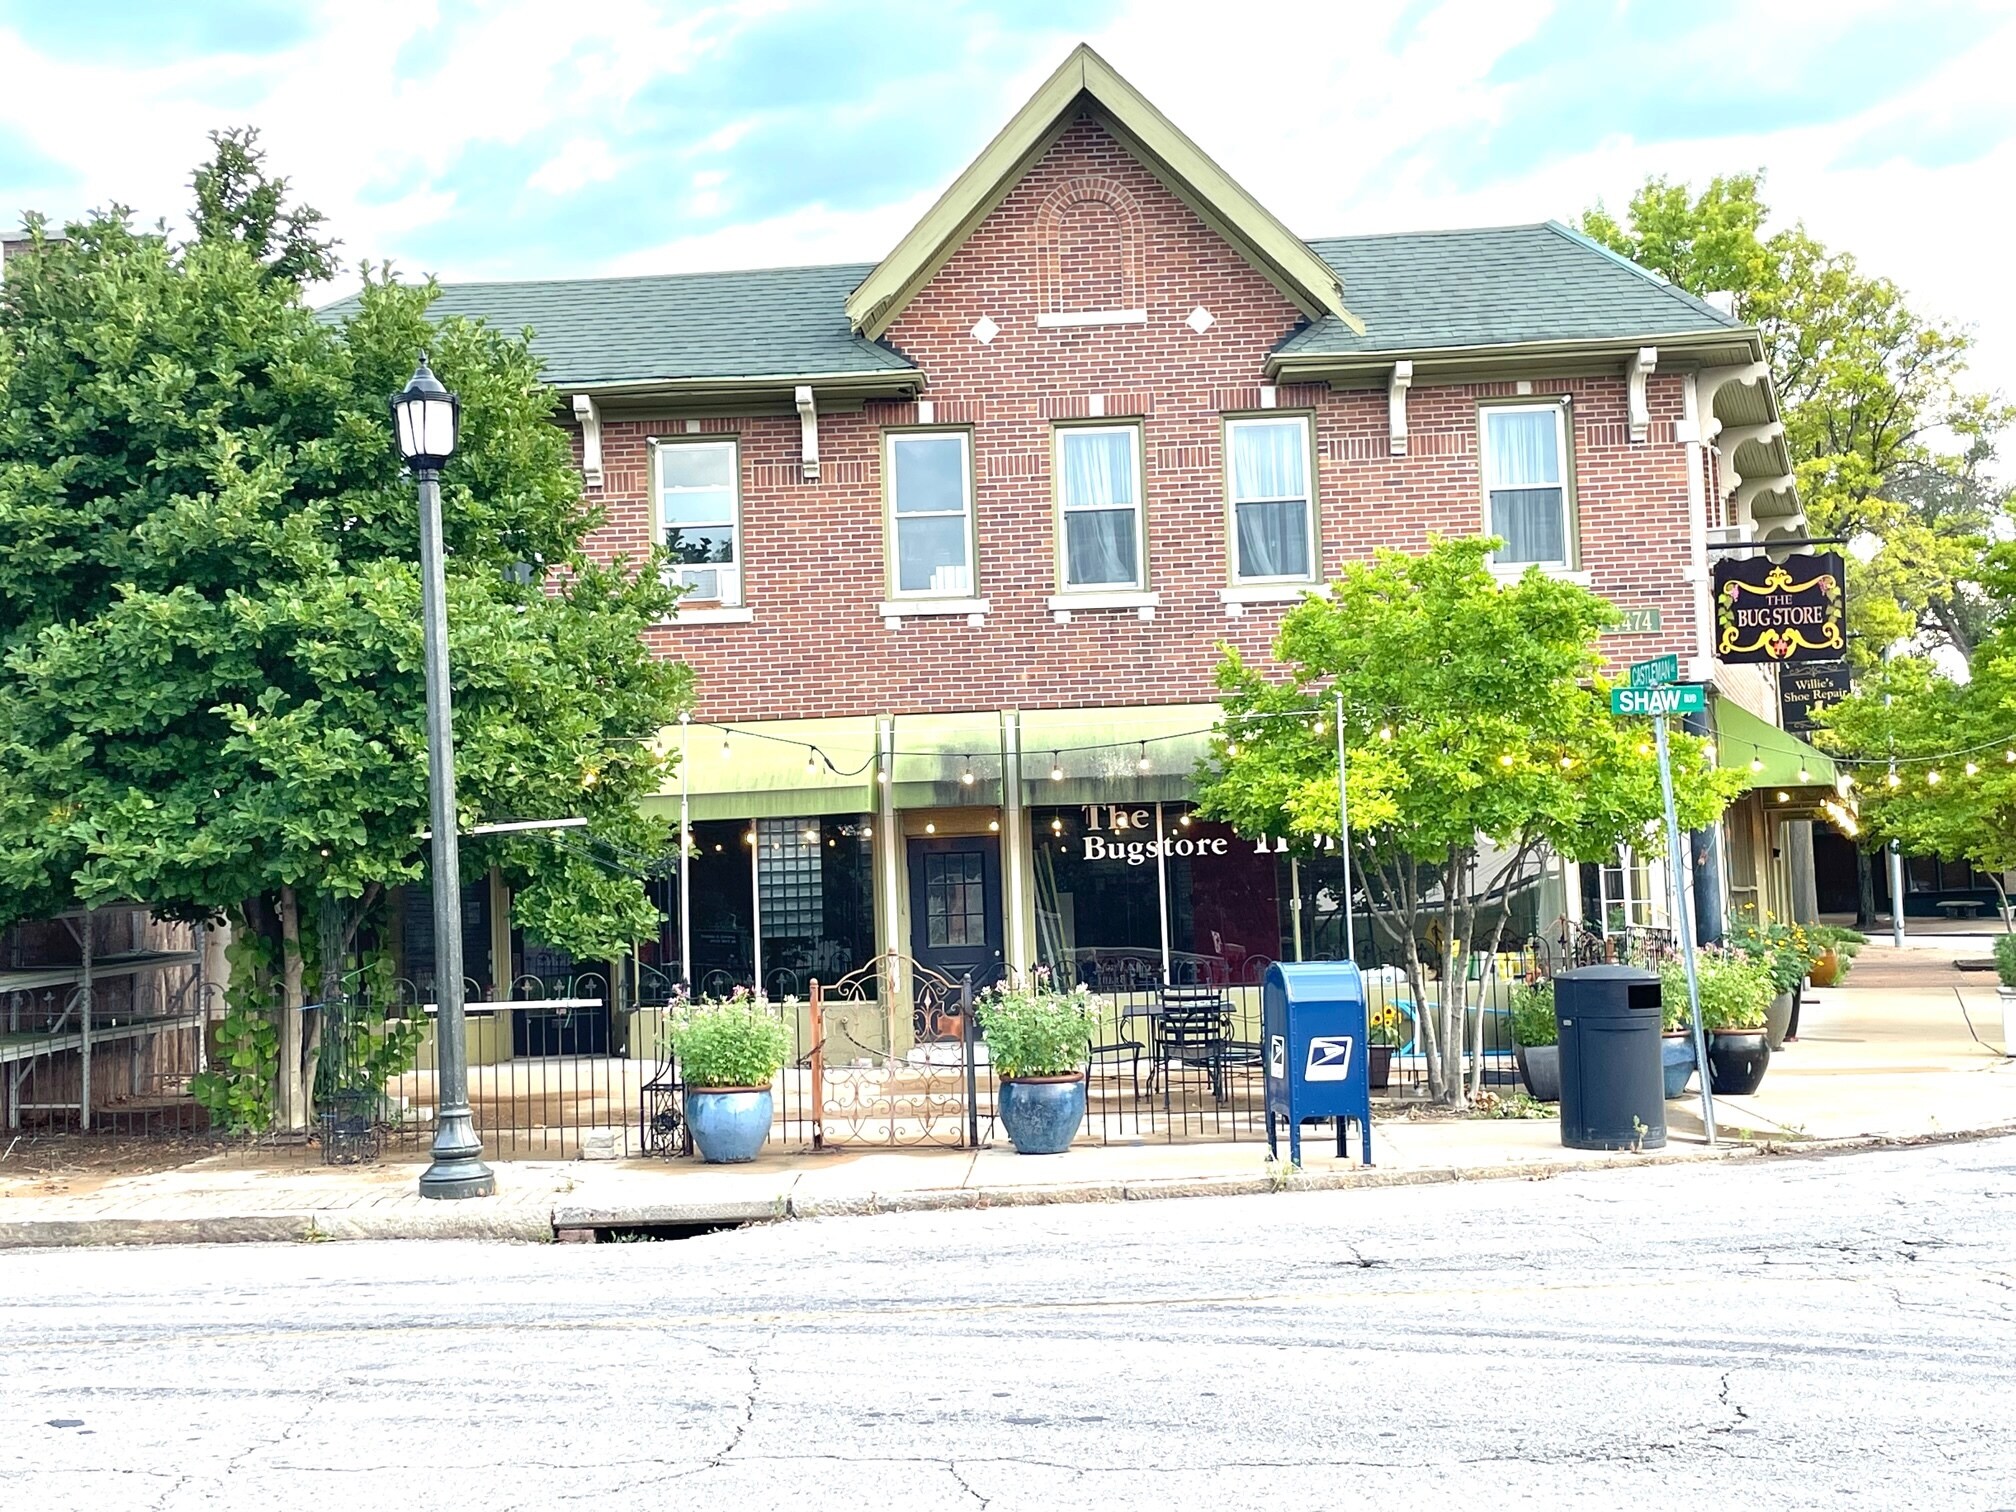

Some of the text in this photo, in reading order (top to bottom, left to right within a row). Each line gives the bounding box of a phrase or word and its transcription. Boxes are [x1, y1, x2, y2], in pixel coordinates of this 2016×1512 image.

[1765, 595, 1793, 606] THE
[1795, 678, 1834, 690] Willie's
[1619, 690, 1681, 713] SHAW
[1784, 687, 1848, 703] Shoe Repair
[1081, 804, 1150, 831] The
[1082, 835, 1228, 866] Bugstore
